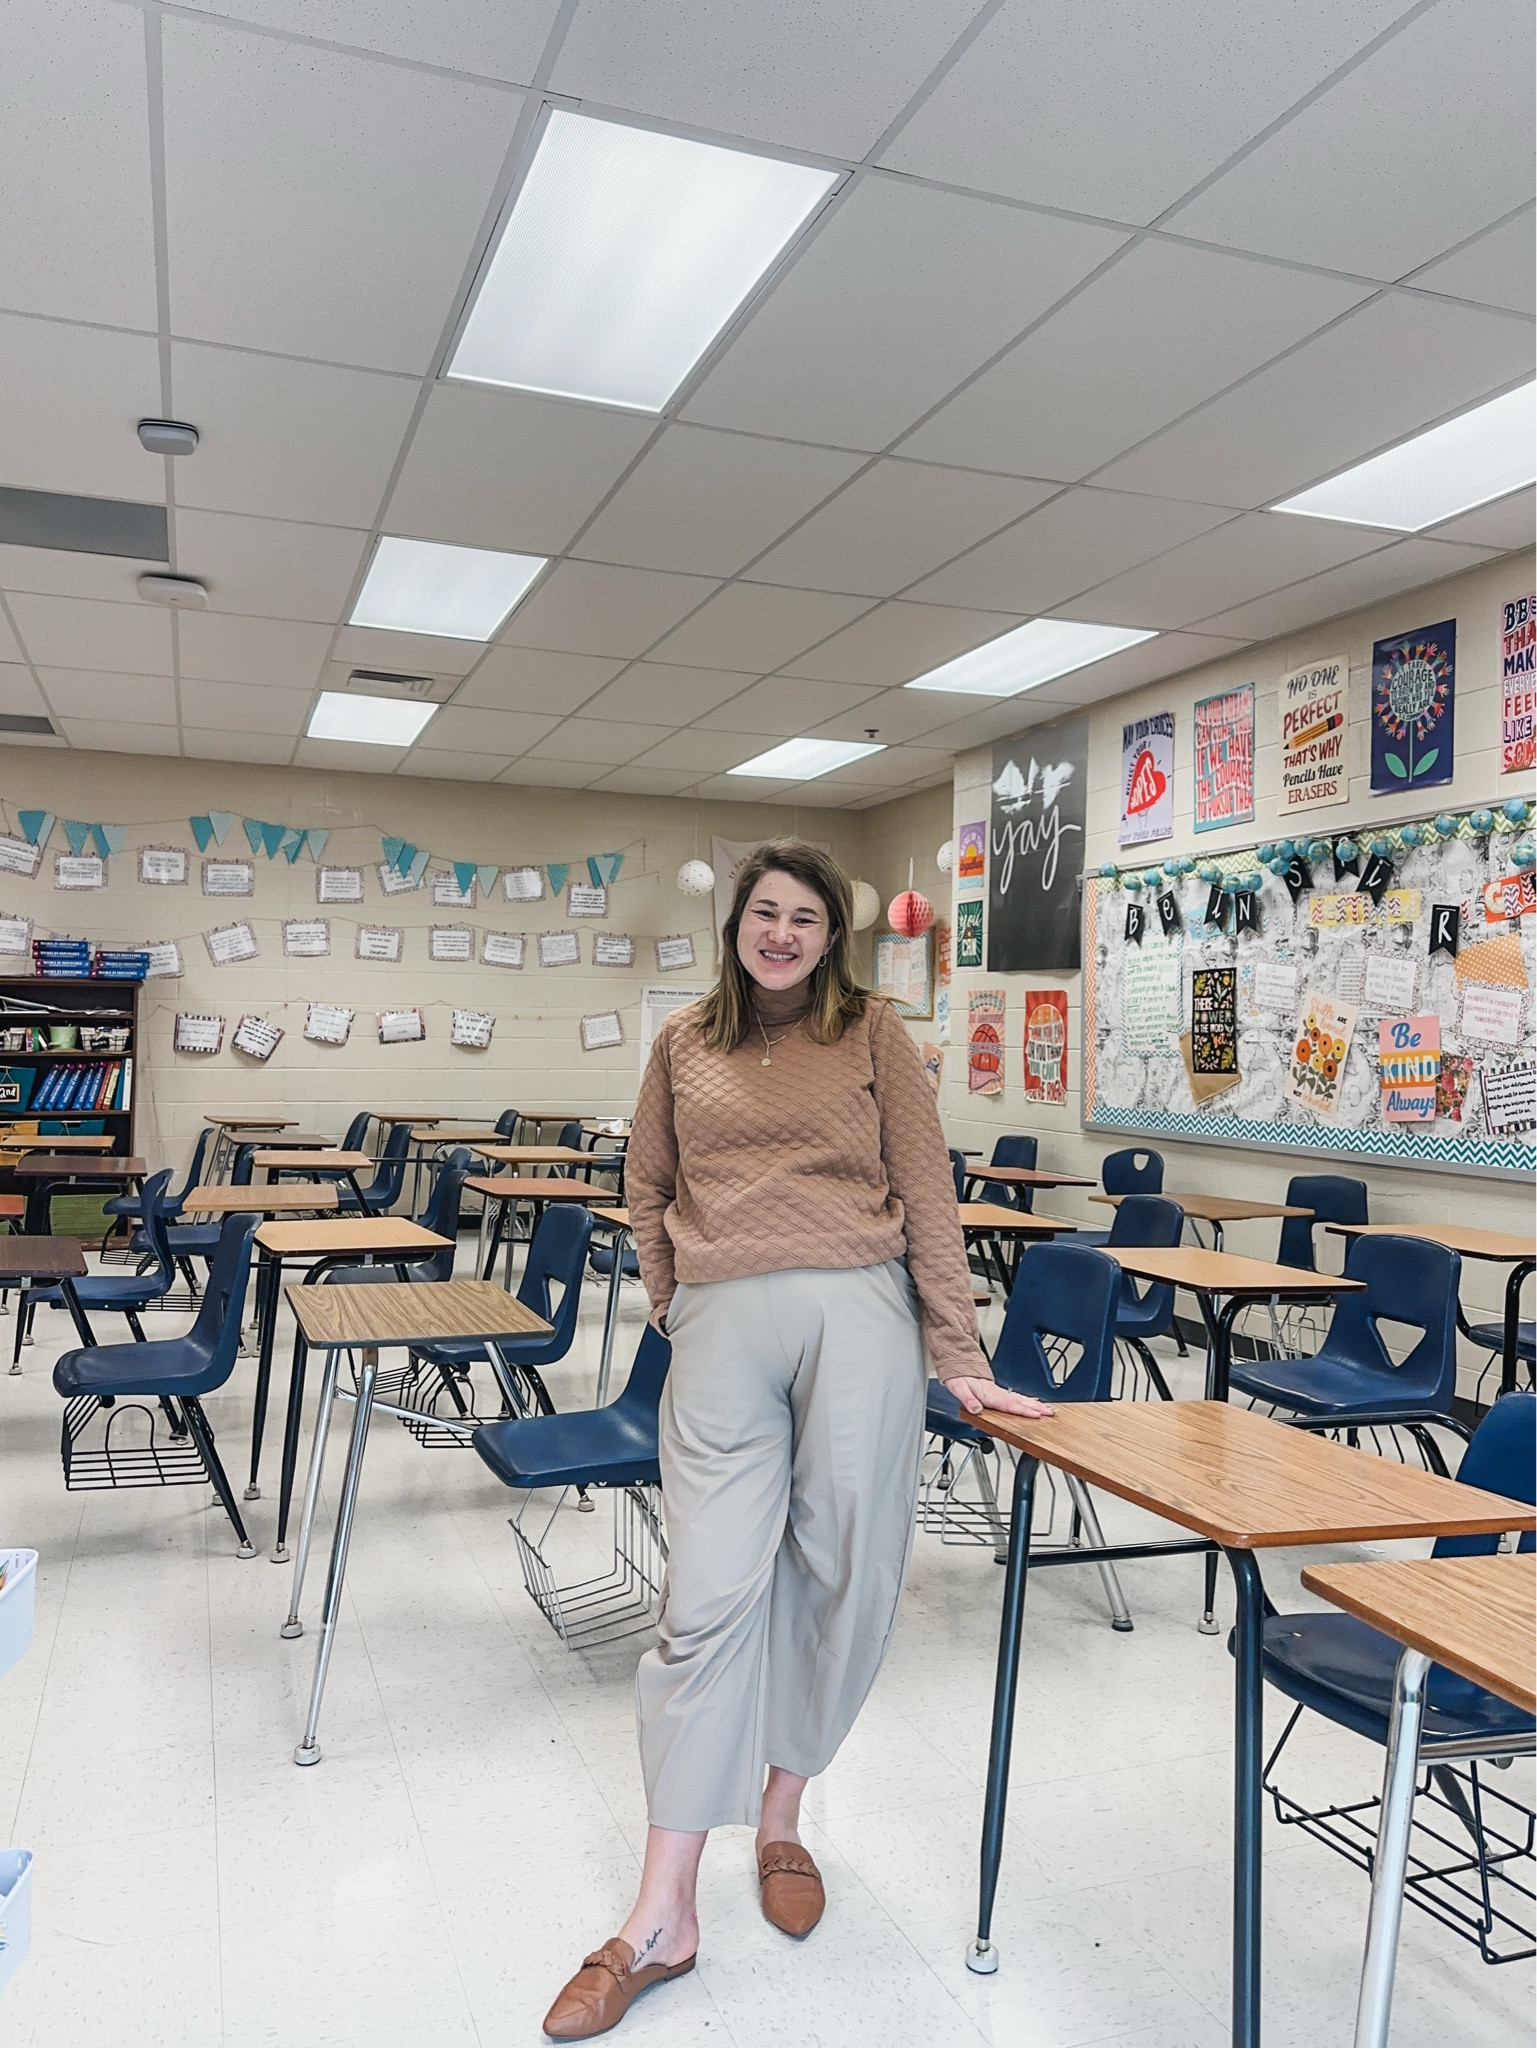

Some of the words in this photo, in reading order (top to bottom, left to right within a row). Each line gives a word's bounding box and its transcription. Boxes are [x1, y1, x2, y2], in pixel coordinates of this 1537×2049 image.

[1504, 598, 1529, 634] BE
[1504, 645, 1536, 677] MAK
[1287, 674, 1307, 699] NO
[1311, 665, 1339, 687] ONE
[1392, 669, 1433, 690] COURAGE
[1307, 690, 1317, 700] IS
[1394, 702, 1416, 714] REALLY
[1417, 697, 1430, 710] ARE
[1283, 690, 1343, 740] PERFECT
[1196, 724, 1210, 748] CAN
[1504, 715, 1533, 743] LIKE
[1196, 747, 1205, 779] IF
[1208, 744, 1223, 773] WE
[1228, 734, 1252, 760] HAVE
[1283, 745, 1317, 769] THAT'S
[1319, 734, 1343, 761] WHY
[1130, 757, 1157, 810] HOPES
[1197, 779, 1211, 801] THE
[1214, 761, 1252, 794] COURAGE
[1283, 769, 1316, 787] Pencils
[1318, 764, 1343, 780] Have
[1288, 781, 1338, 804] ERASERS
[1196, 801, 1207, 823] TO
[993, 805, 1082, 895] yay
[1194, 997, 1213, 1011] THERE
[1194, 1010, 1232, 1024] POWER
[1200, 1024, 1209, 1033] THE
[1337, 1016, 1348, 1025] ARE
[1391, 1022, 1421, 1048] Be
[1036, 1042, 1046, 1062] YOU
[1047, 1044, 1063, 1061] THINK
[1383, 1055, 1436, 1084] KIND
[0, 1087, 16, 1099] 2nd
[1386, 1090, 1435, 1118] Always
